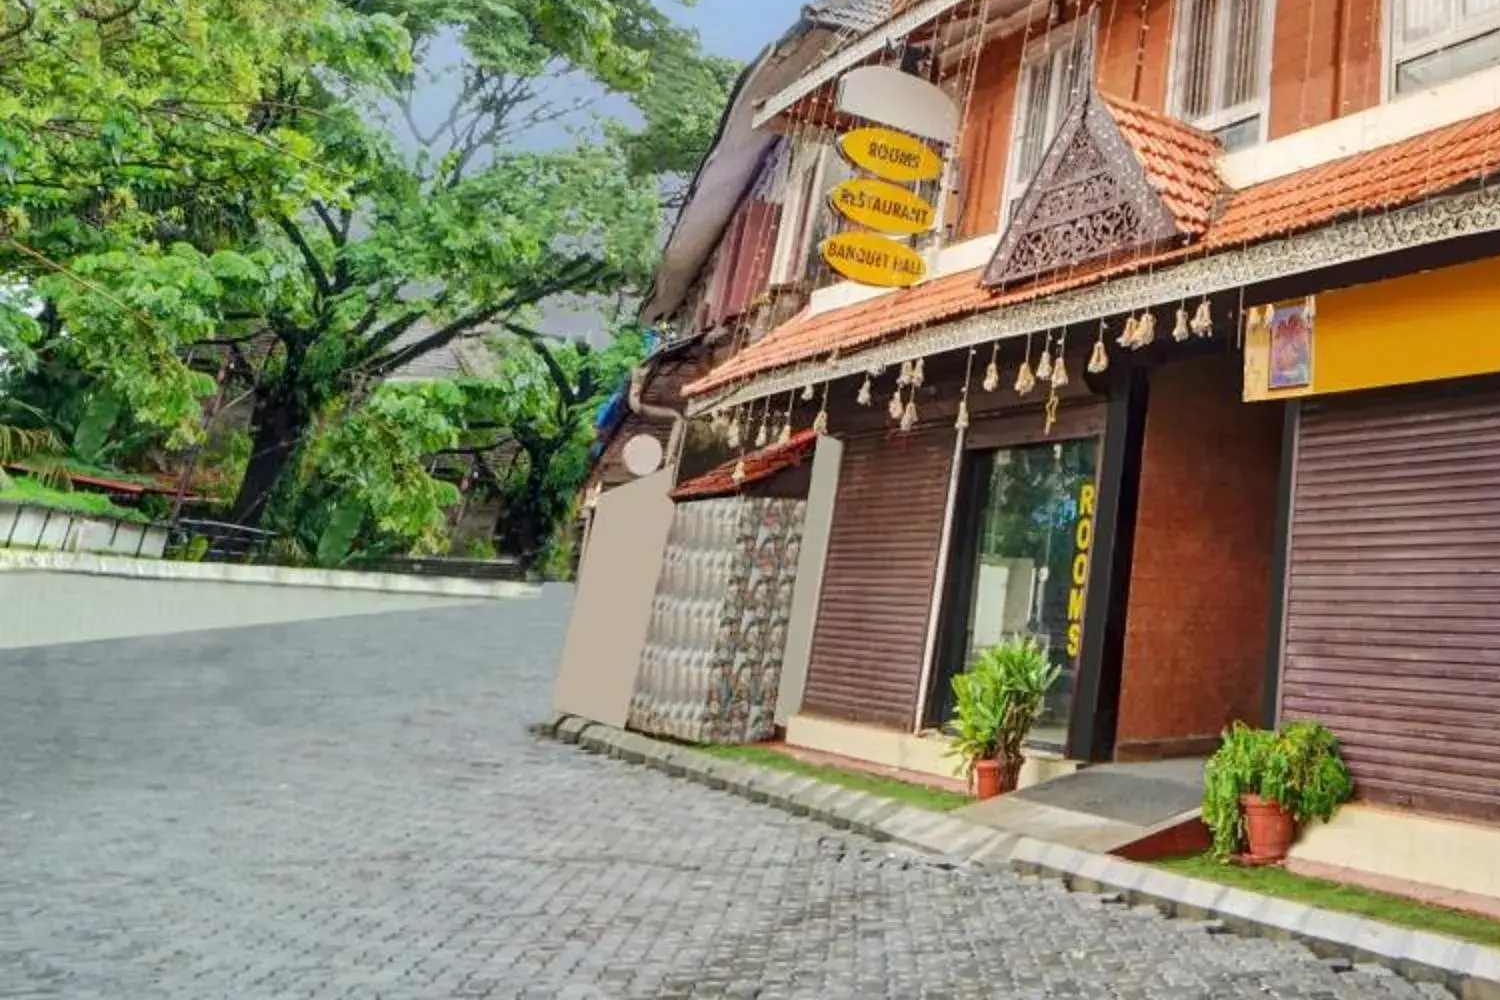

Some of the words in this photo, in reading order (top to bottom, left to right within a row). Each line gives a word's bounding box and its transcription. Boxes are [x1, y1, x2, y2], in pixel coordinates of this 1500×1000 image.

[867, 141, 921, 169] ROOMS
[839, 188, 929, 225] RESTAURANT
[827, 241, 888, 270] BANQUET
[893, 257, 921, 276] HALL
[1066, 484, 1095, 658] ROOMS
